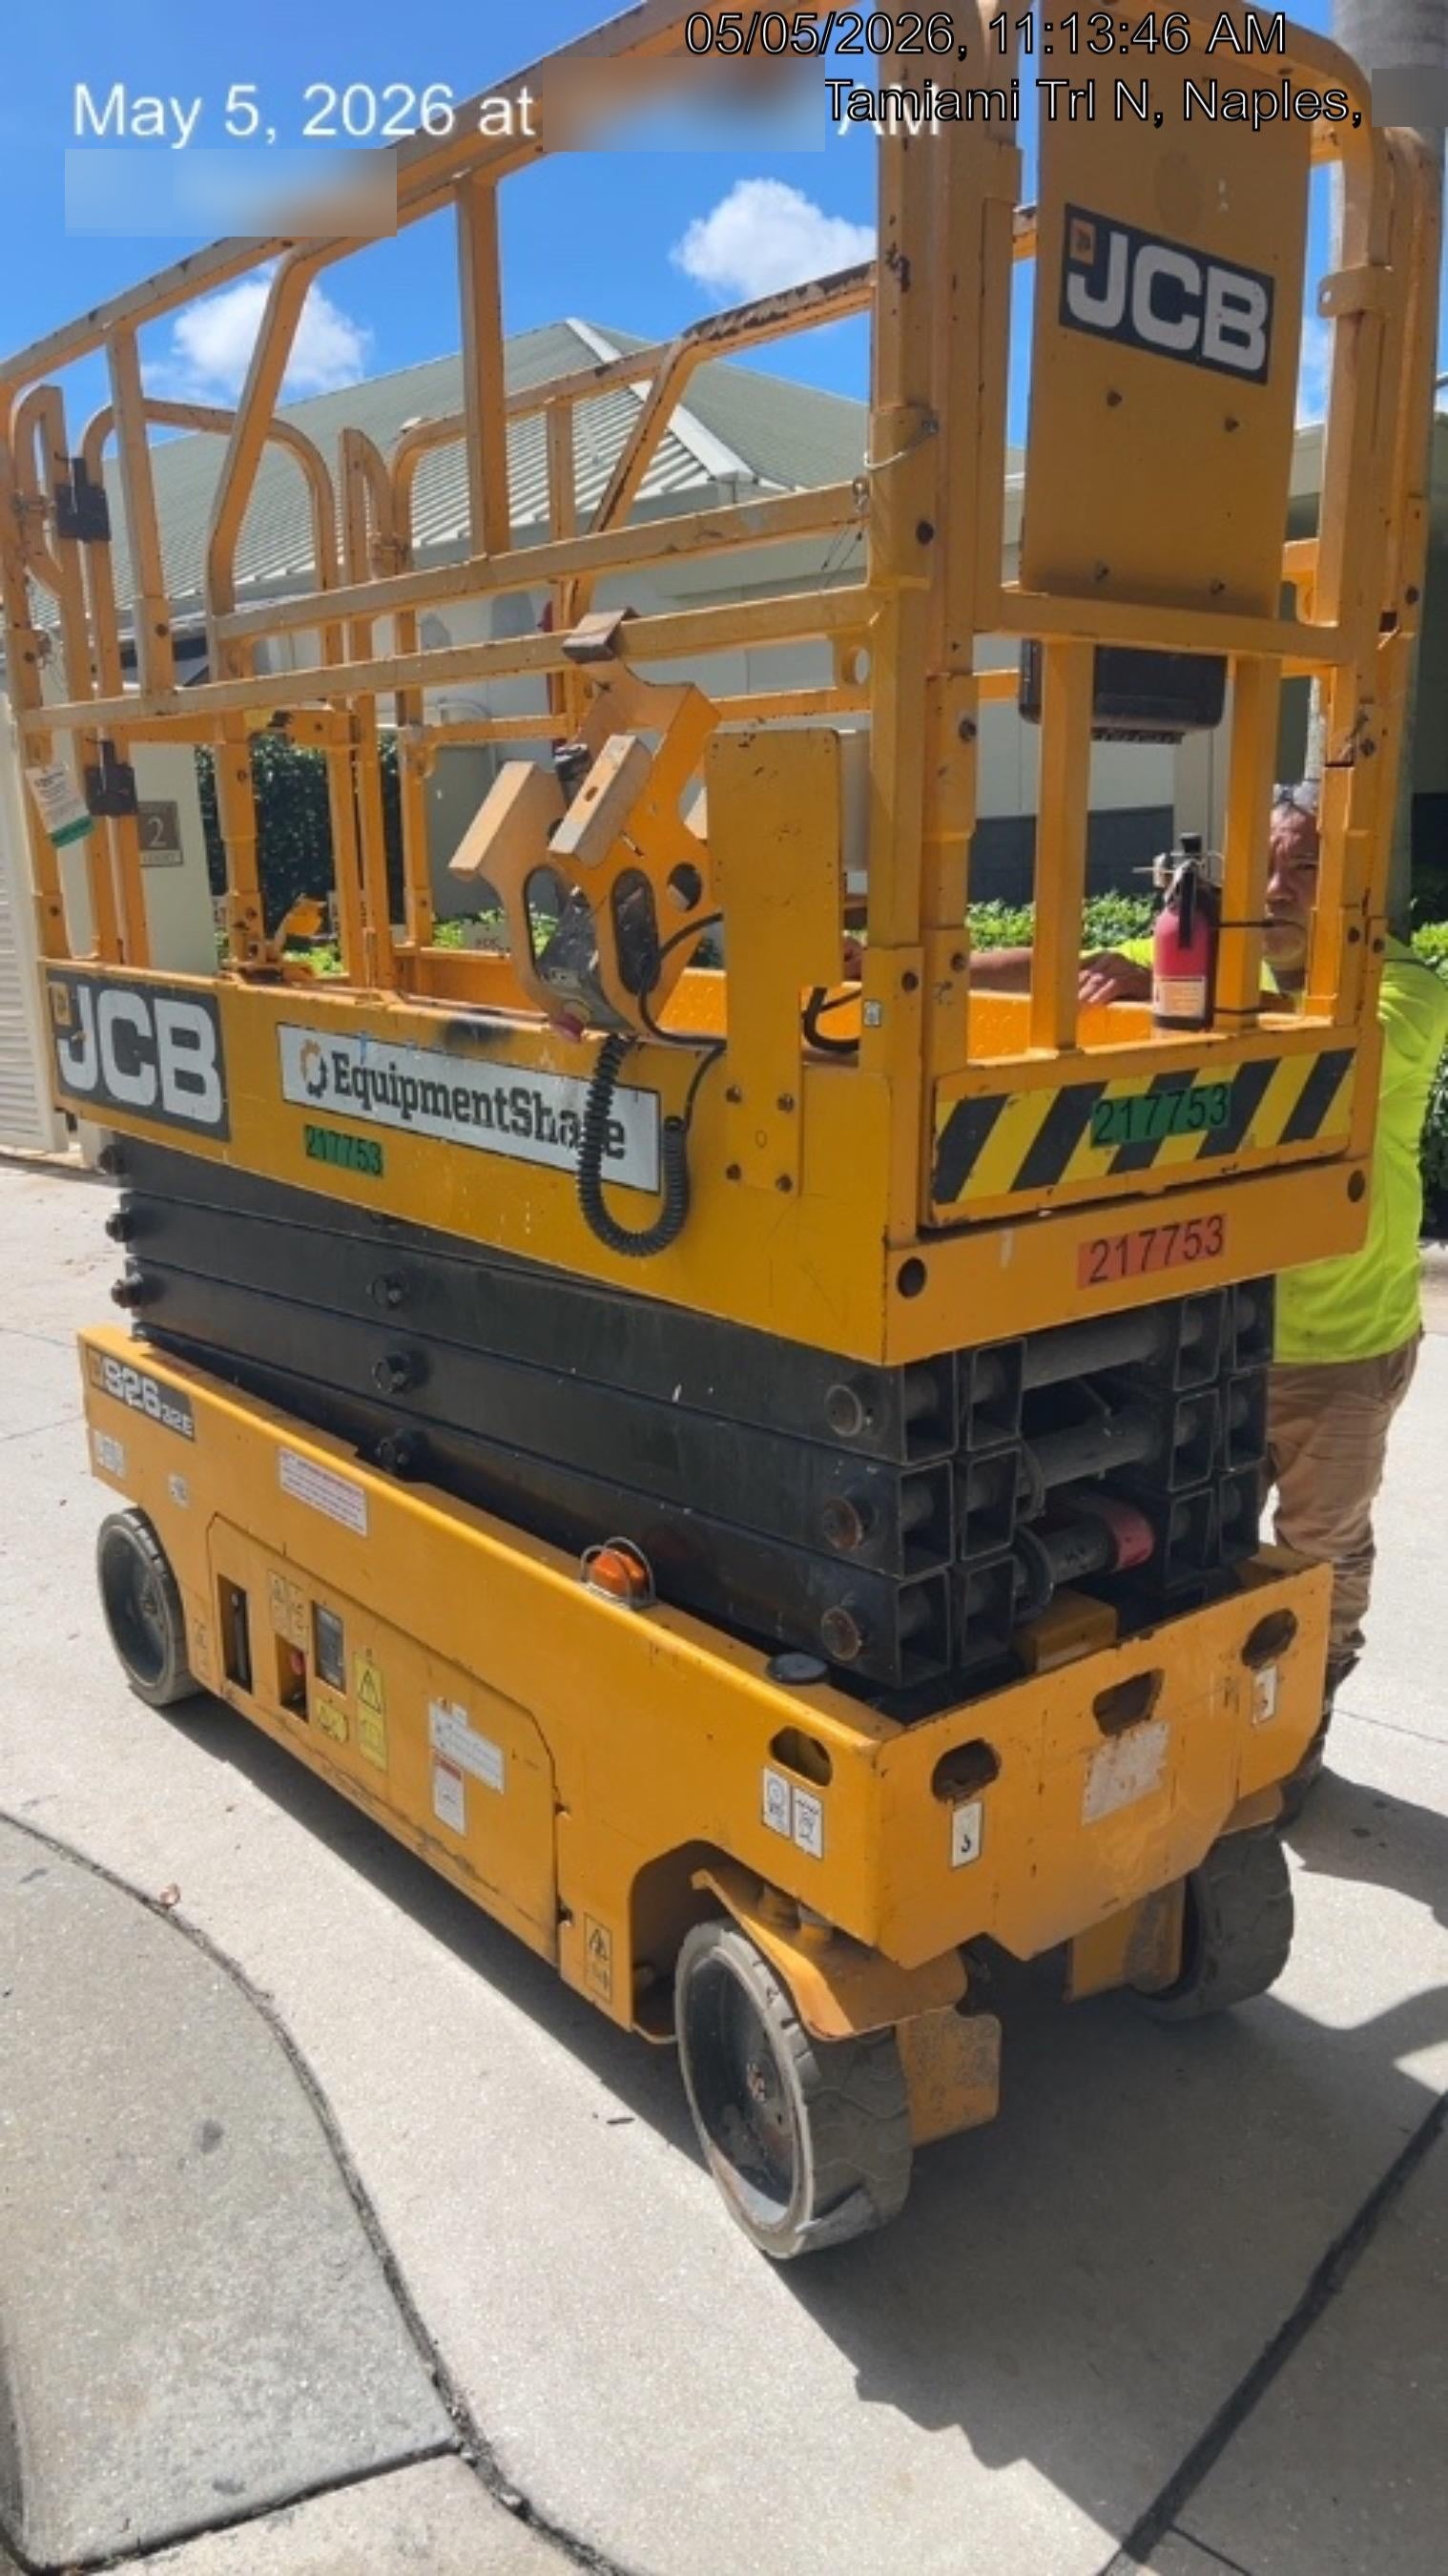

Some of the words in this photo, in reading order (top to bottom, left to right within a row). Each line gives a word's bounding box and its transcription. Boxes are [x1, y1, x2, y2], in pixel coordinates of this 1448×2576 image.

[1066, 231, 1268, 371] JCB
[147, 816, 168, 847] 2
[56, 984, 223, 1124] JCB
[332, 1051, 626, 1160] EquipmentShae
[1093, 1084, 1230, 1143] 217753
[1088, 1215, 1225, 1284] 217753
